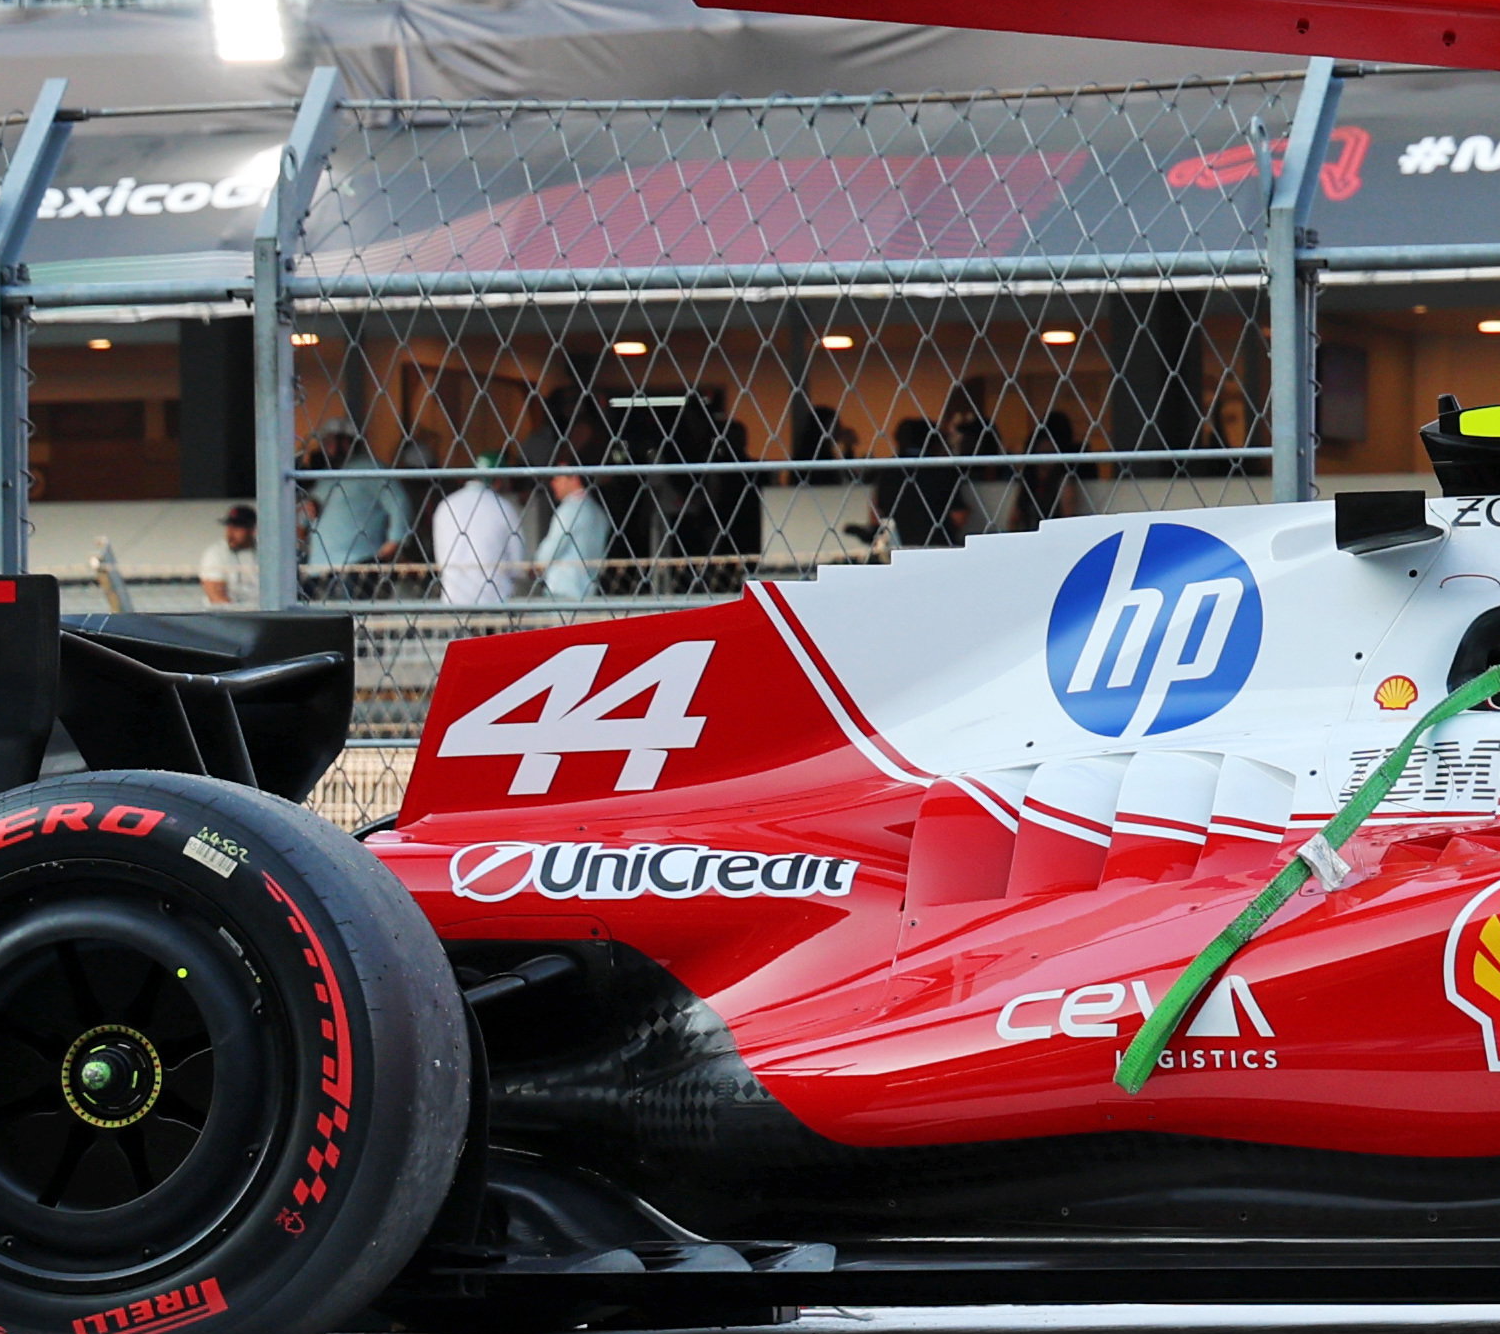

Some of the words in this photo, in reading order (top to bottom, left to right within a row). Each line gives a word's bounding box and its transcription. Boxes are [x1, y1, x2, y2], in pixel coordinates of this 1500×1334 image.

[1066, 524, 1245, 738] hp
[436, 640, 717, 796] 44
[538, 844, 850, 894] UniCredit
[1115, 1049, 1279, 1070] LGISTICS
